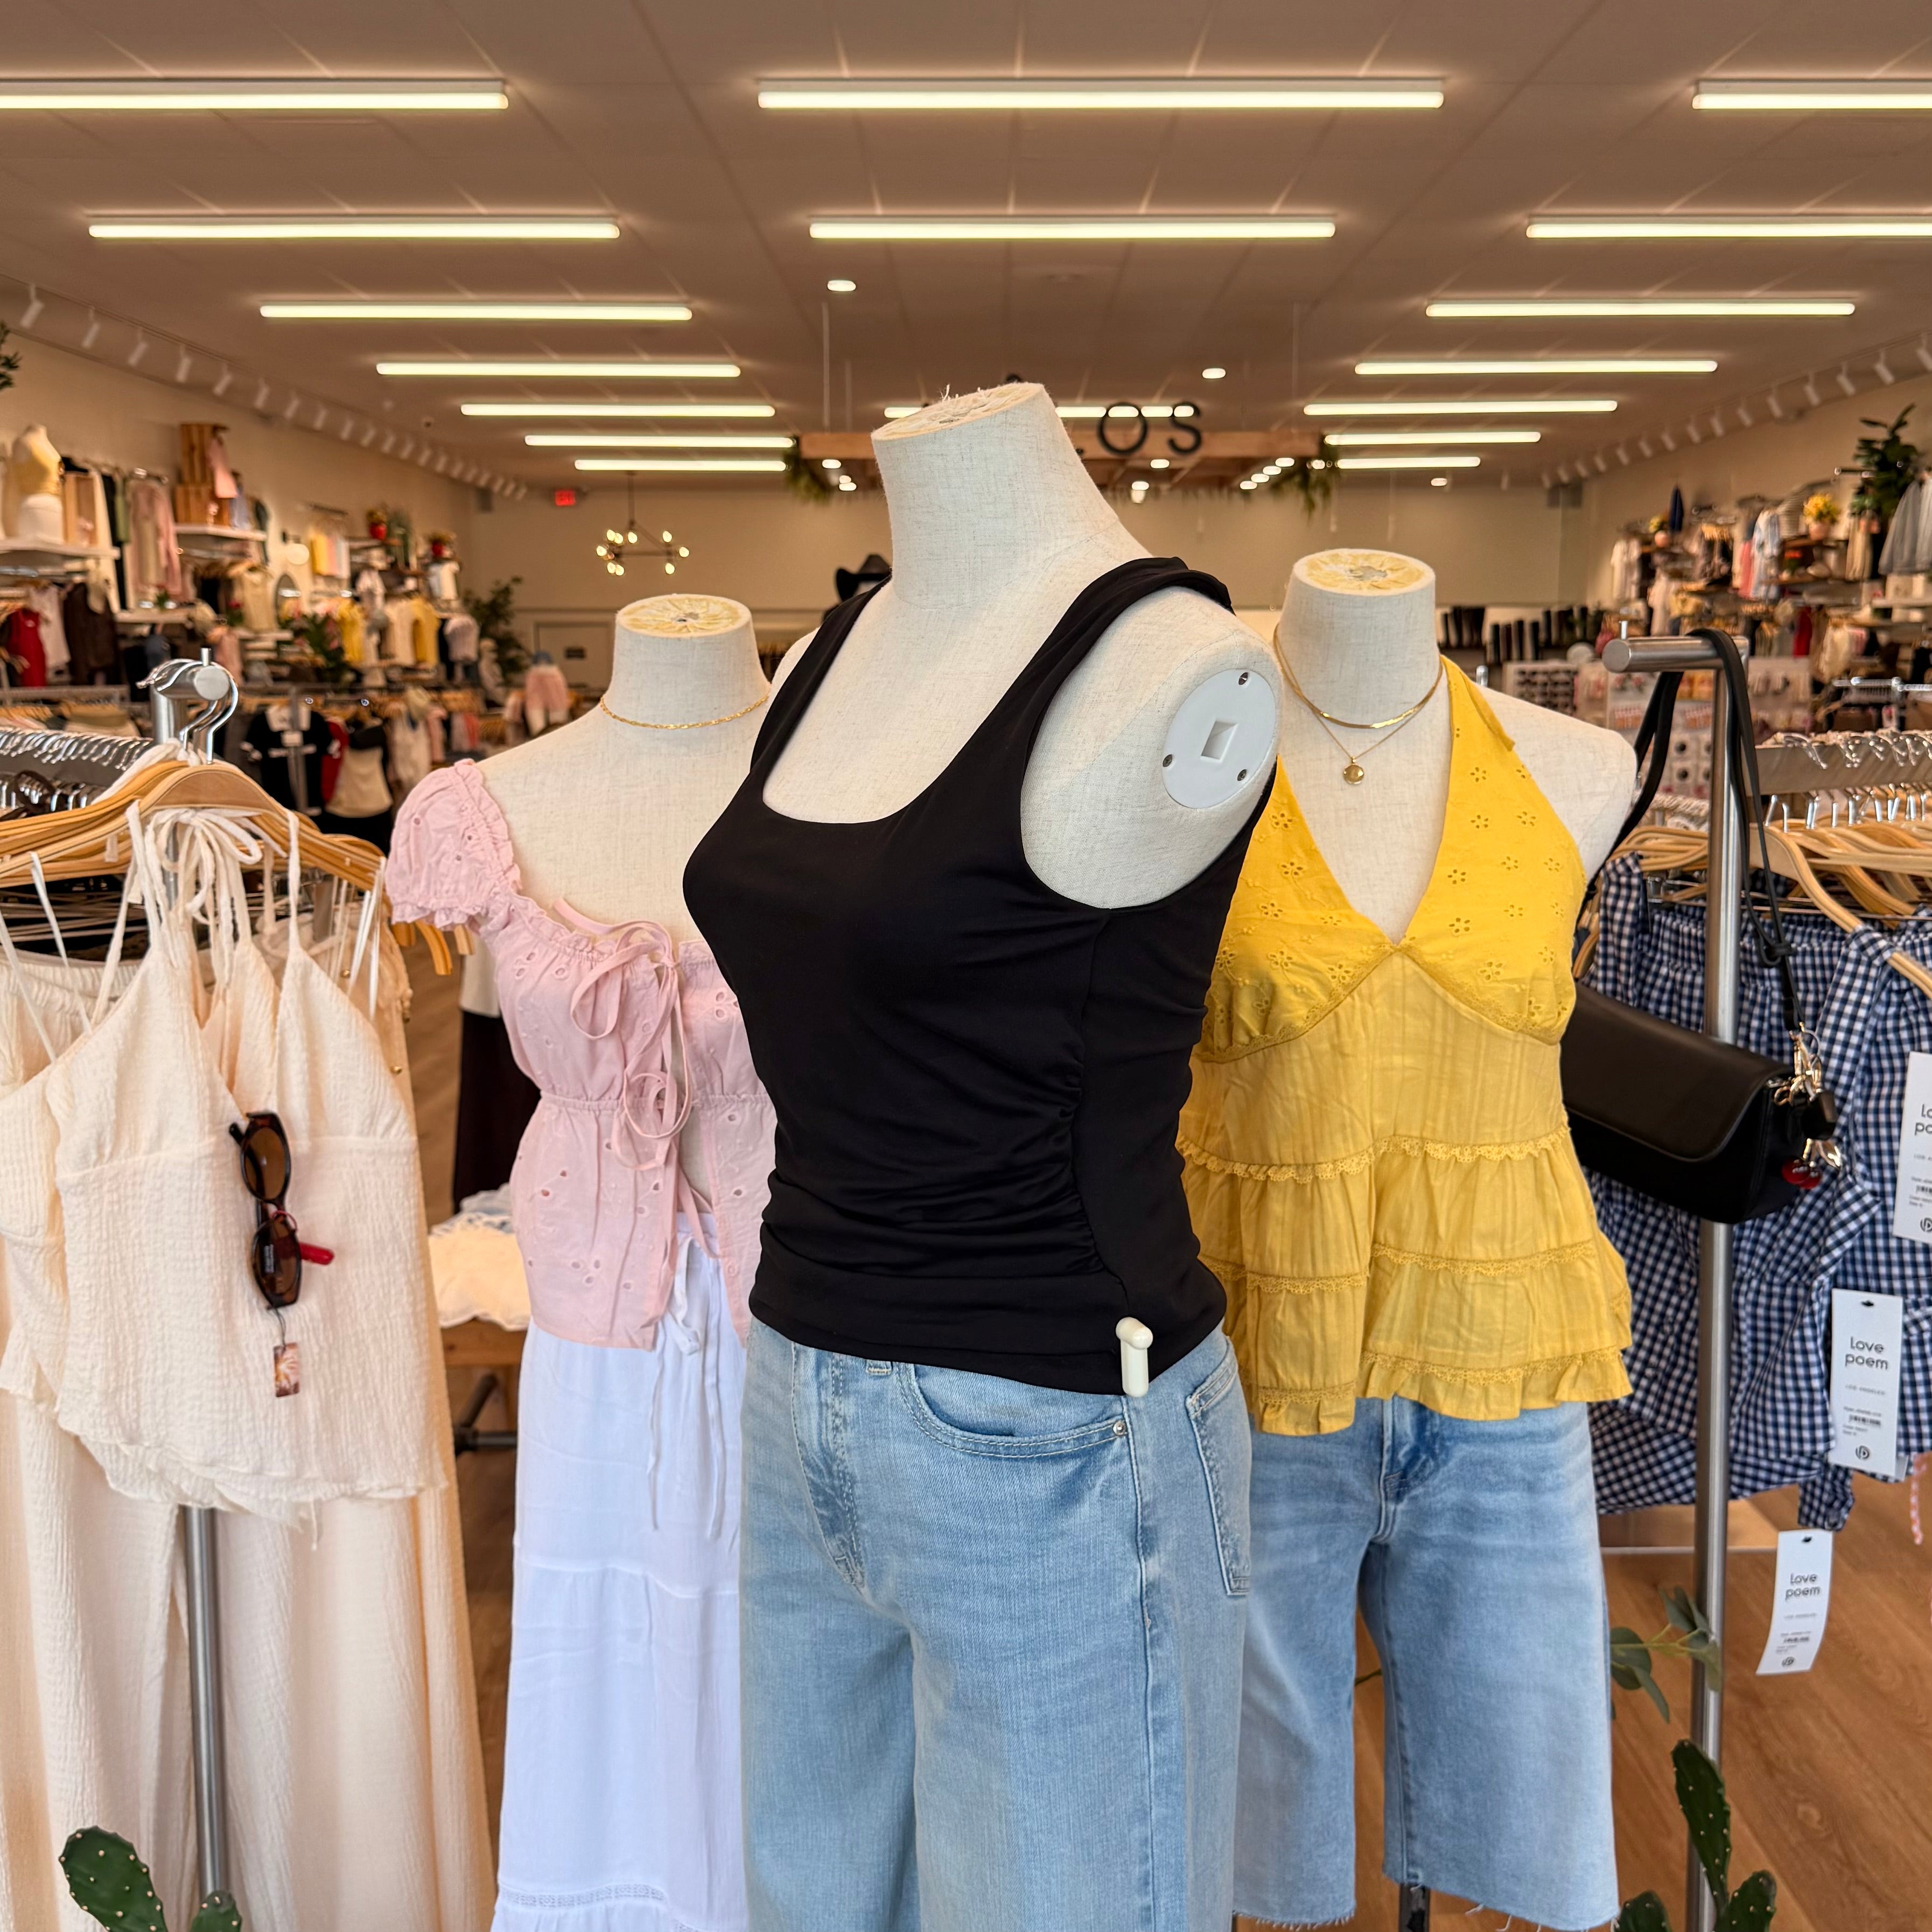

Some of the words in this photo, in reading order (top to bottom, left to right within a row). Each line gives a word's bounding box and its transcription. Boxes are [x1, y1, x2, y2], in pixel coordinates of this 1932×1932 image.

[1096, 402, 1202, 454] OS
[1850, 1336, 1884, 1354] Love
[1844, 1353, 1888, 1370] poem
[1790, 1573, 1818, 1585] Love
[1784, 1586, 1821, 1602] poem
